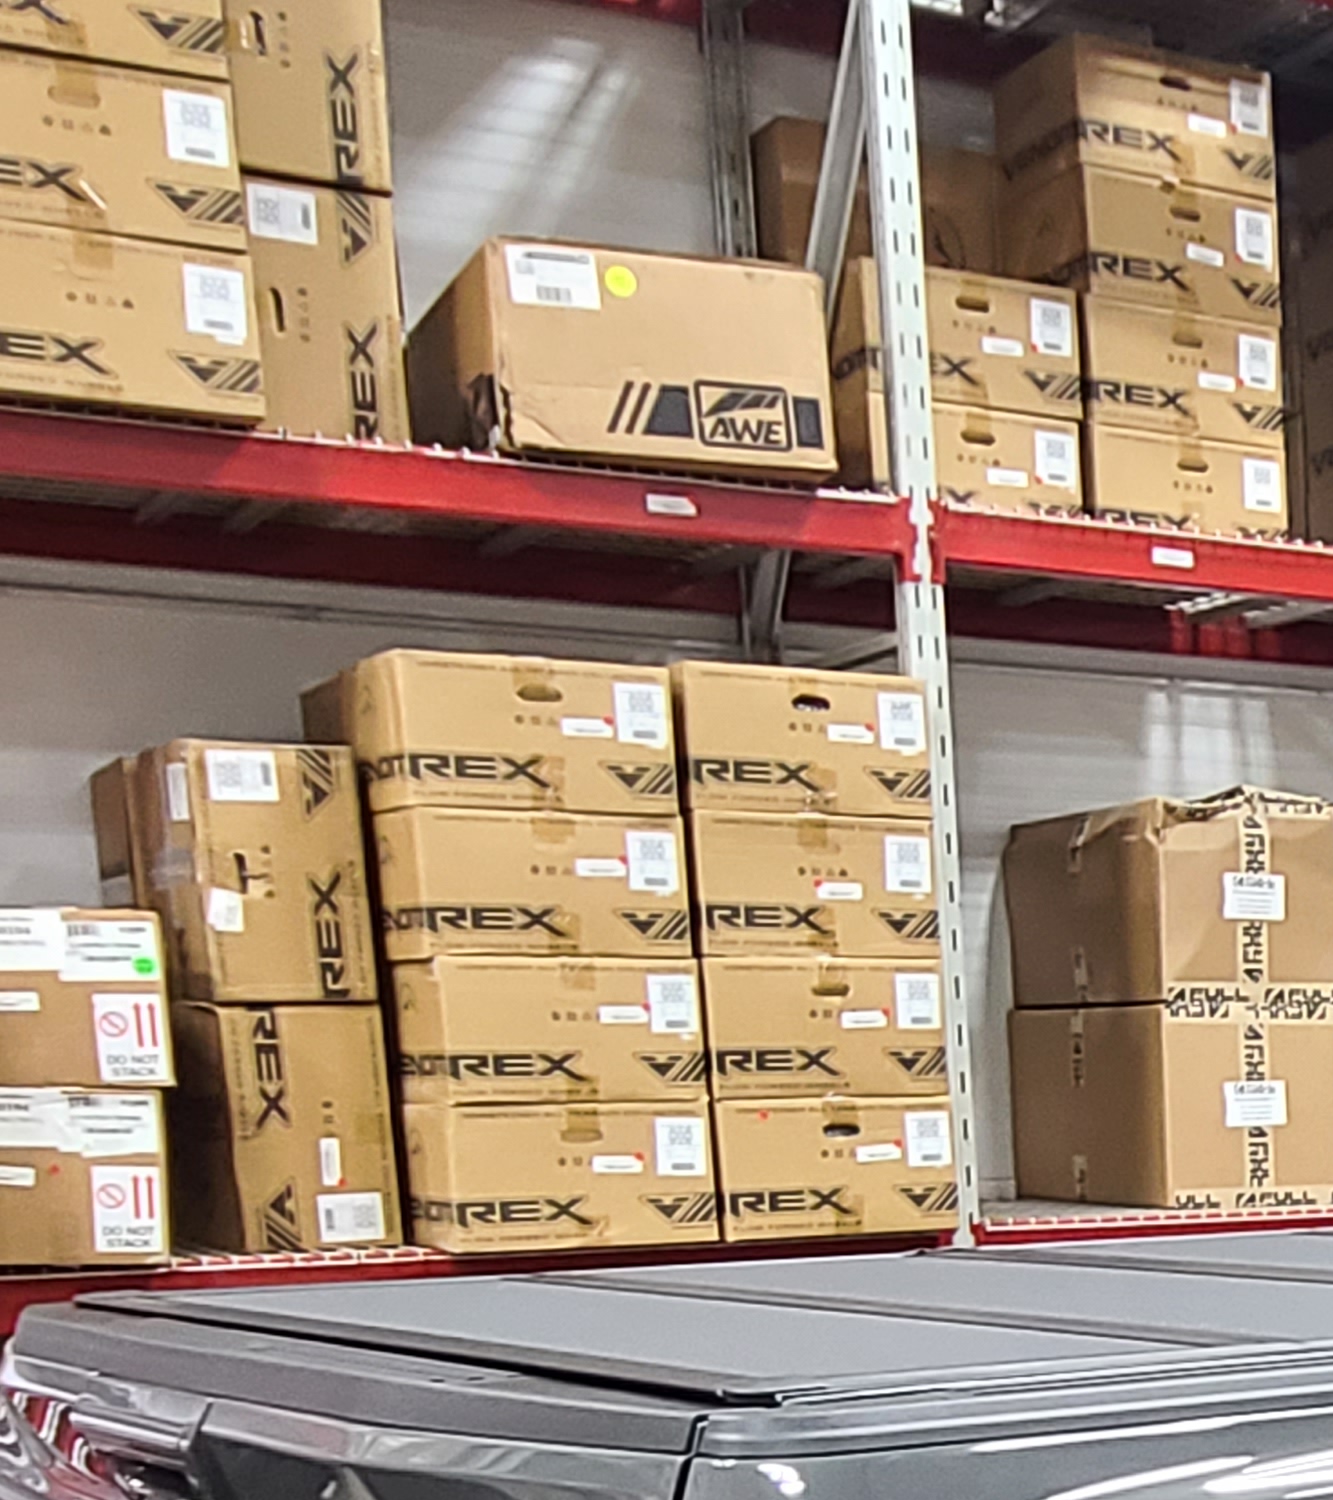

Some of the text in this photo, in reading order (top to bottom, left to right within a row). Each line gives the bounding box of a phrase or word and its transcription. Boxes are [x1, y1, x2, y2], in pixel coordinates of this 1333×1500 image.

[326, 53, 363, 188] REX
[1081, 119, 1182, 162] REX
[0, 157, 90, 202] EX
[1089, 250, 1190, 292] REX
[0, 331, 112, 377] EX
[1095, 380, 1190, 417] REX
[709, 416, 783, 446] AWE
[406, 753, 553, 789] REX
[693, 758, 822, 793] REX
[309, 871, 351, 999] REX
[426, 906, 570, 938] REX
[705, 904, 832, 935] REX
[106, 1054, 159, 1066] DO NOT
[111, 1066, 157, 1077] STACK
[246, 1006, 291, 1131] REX
[448, 1053, 592, 1082] REX
[716, 1048, 841, 1077] REX
[454, 1197, 594, 1229] REX
[728, 1187, 854, 1218] REX
[102, 1226, 155, 1237] DO NOT
[106, 1238, 151, 1248] STACK
